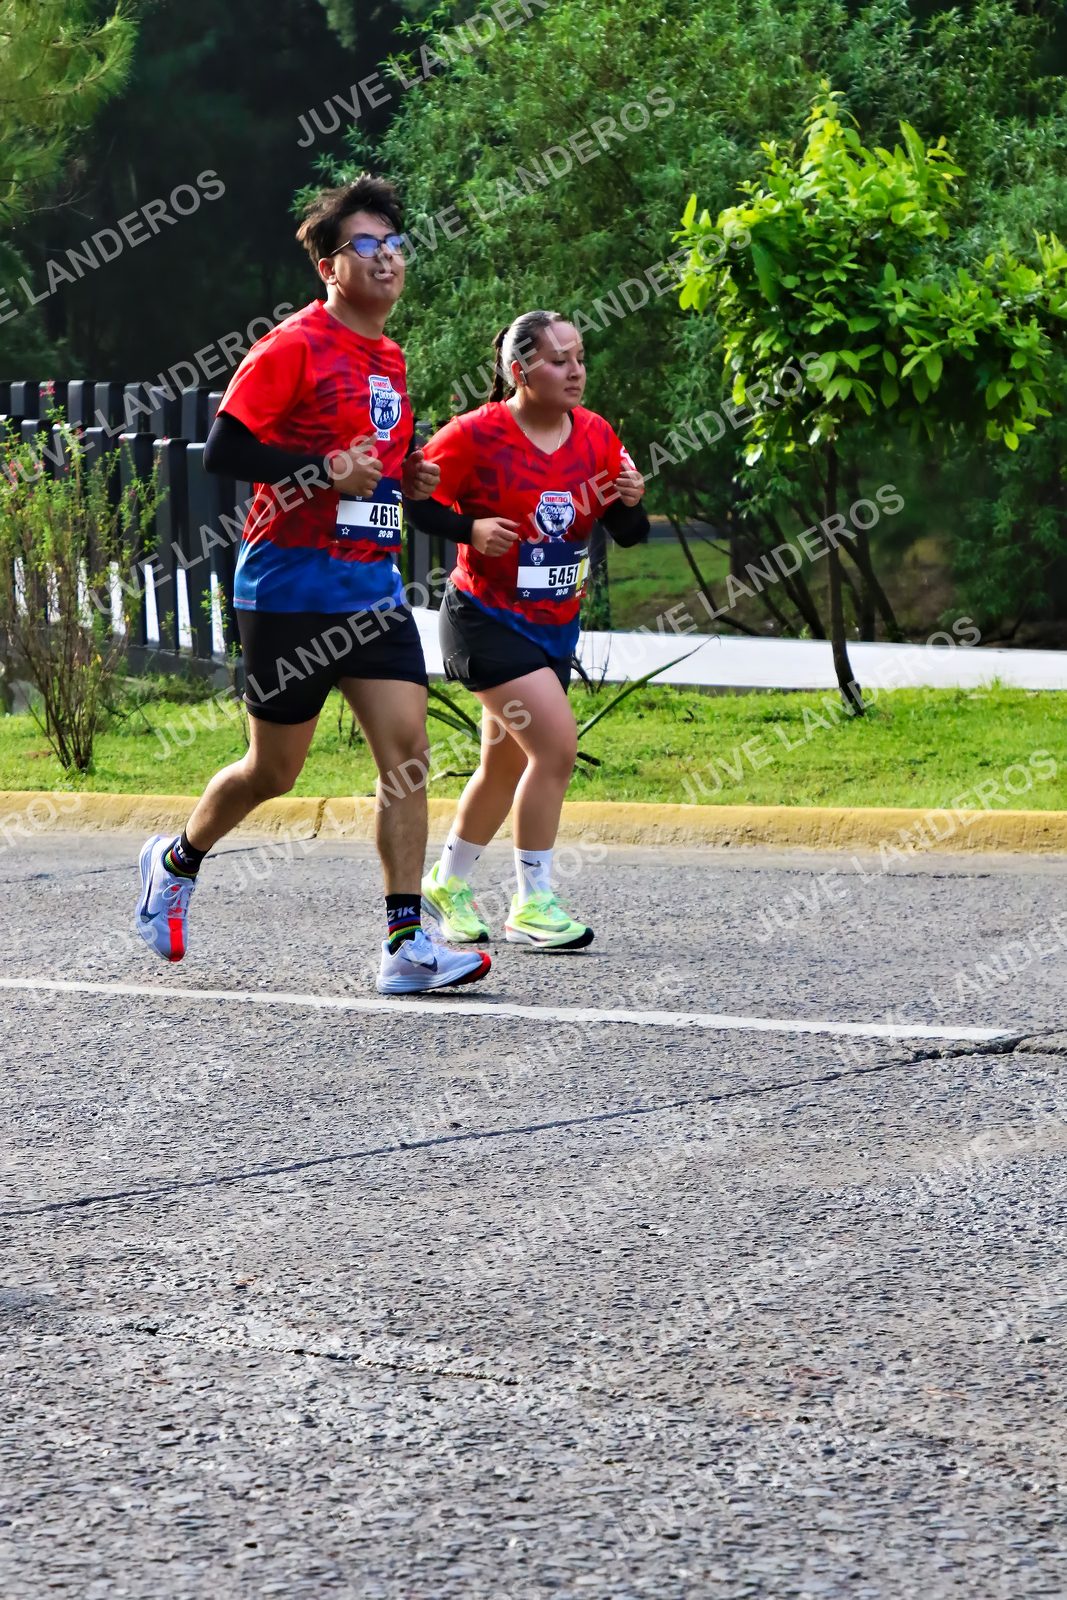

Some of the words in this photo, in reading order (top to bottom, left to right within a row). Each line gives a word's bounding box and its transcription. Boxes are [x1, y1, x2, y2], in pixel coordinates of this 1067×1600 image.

[369, 505, 399, 528] 4615
[548, 564, 579, 586] 5451
[388, 905, 417, 922] 21K
